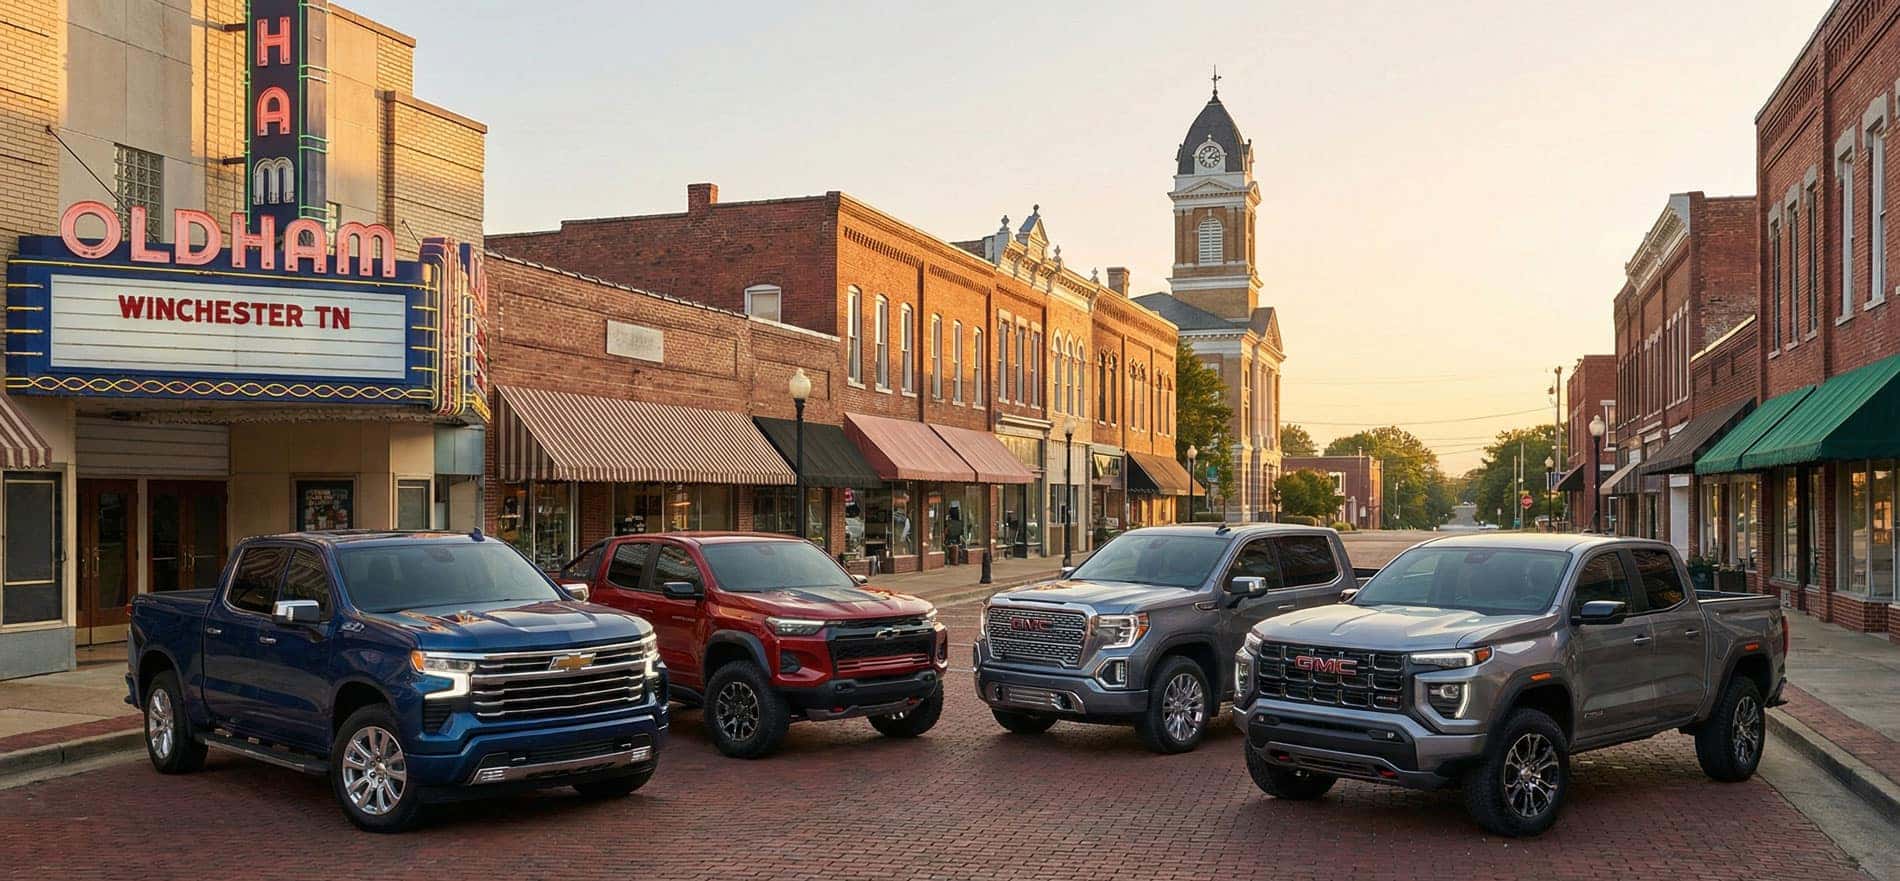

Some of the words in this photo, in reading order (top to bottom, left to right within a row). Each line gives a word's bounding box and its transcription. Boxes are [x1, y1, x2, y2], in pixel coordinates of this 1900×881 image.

[60, 201, 397, 278] OLDHAM
[118, 295, 304, 328] WINCHESTER
[314, 305, 351, 330] TN
[1295, 655, 1358, 675] GMC
